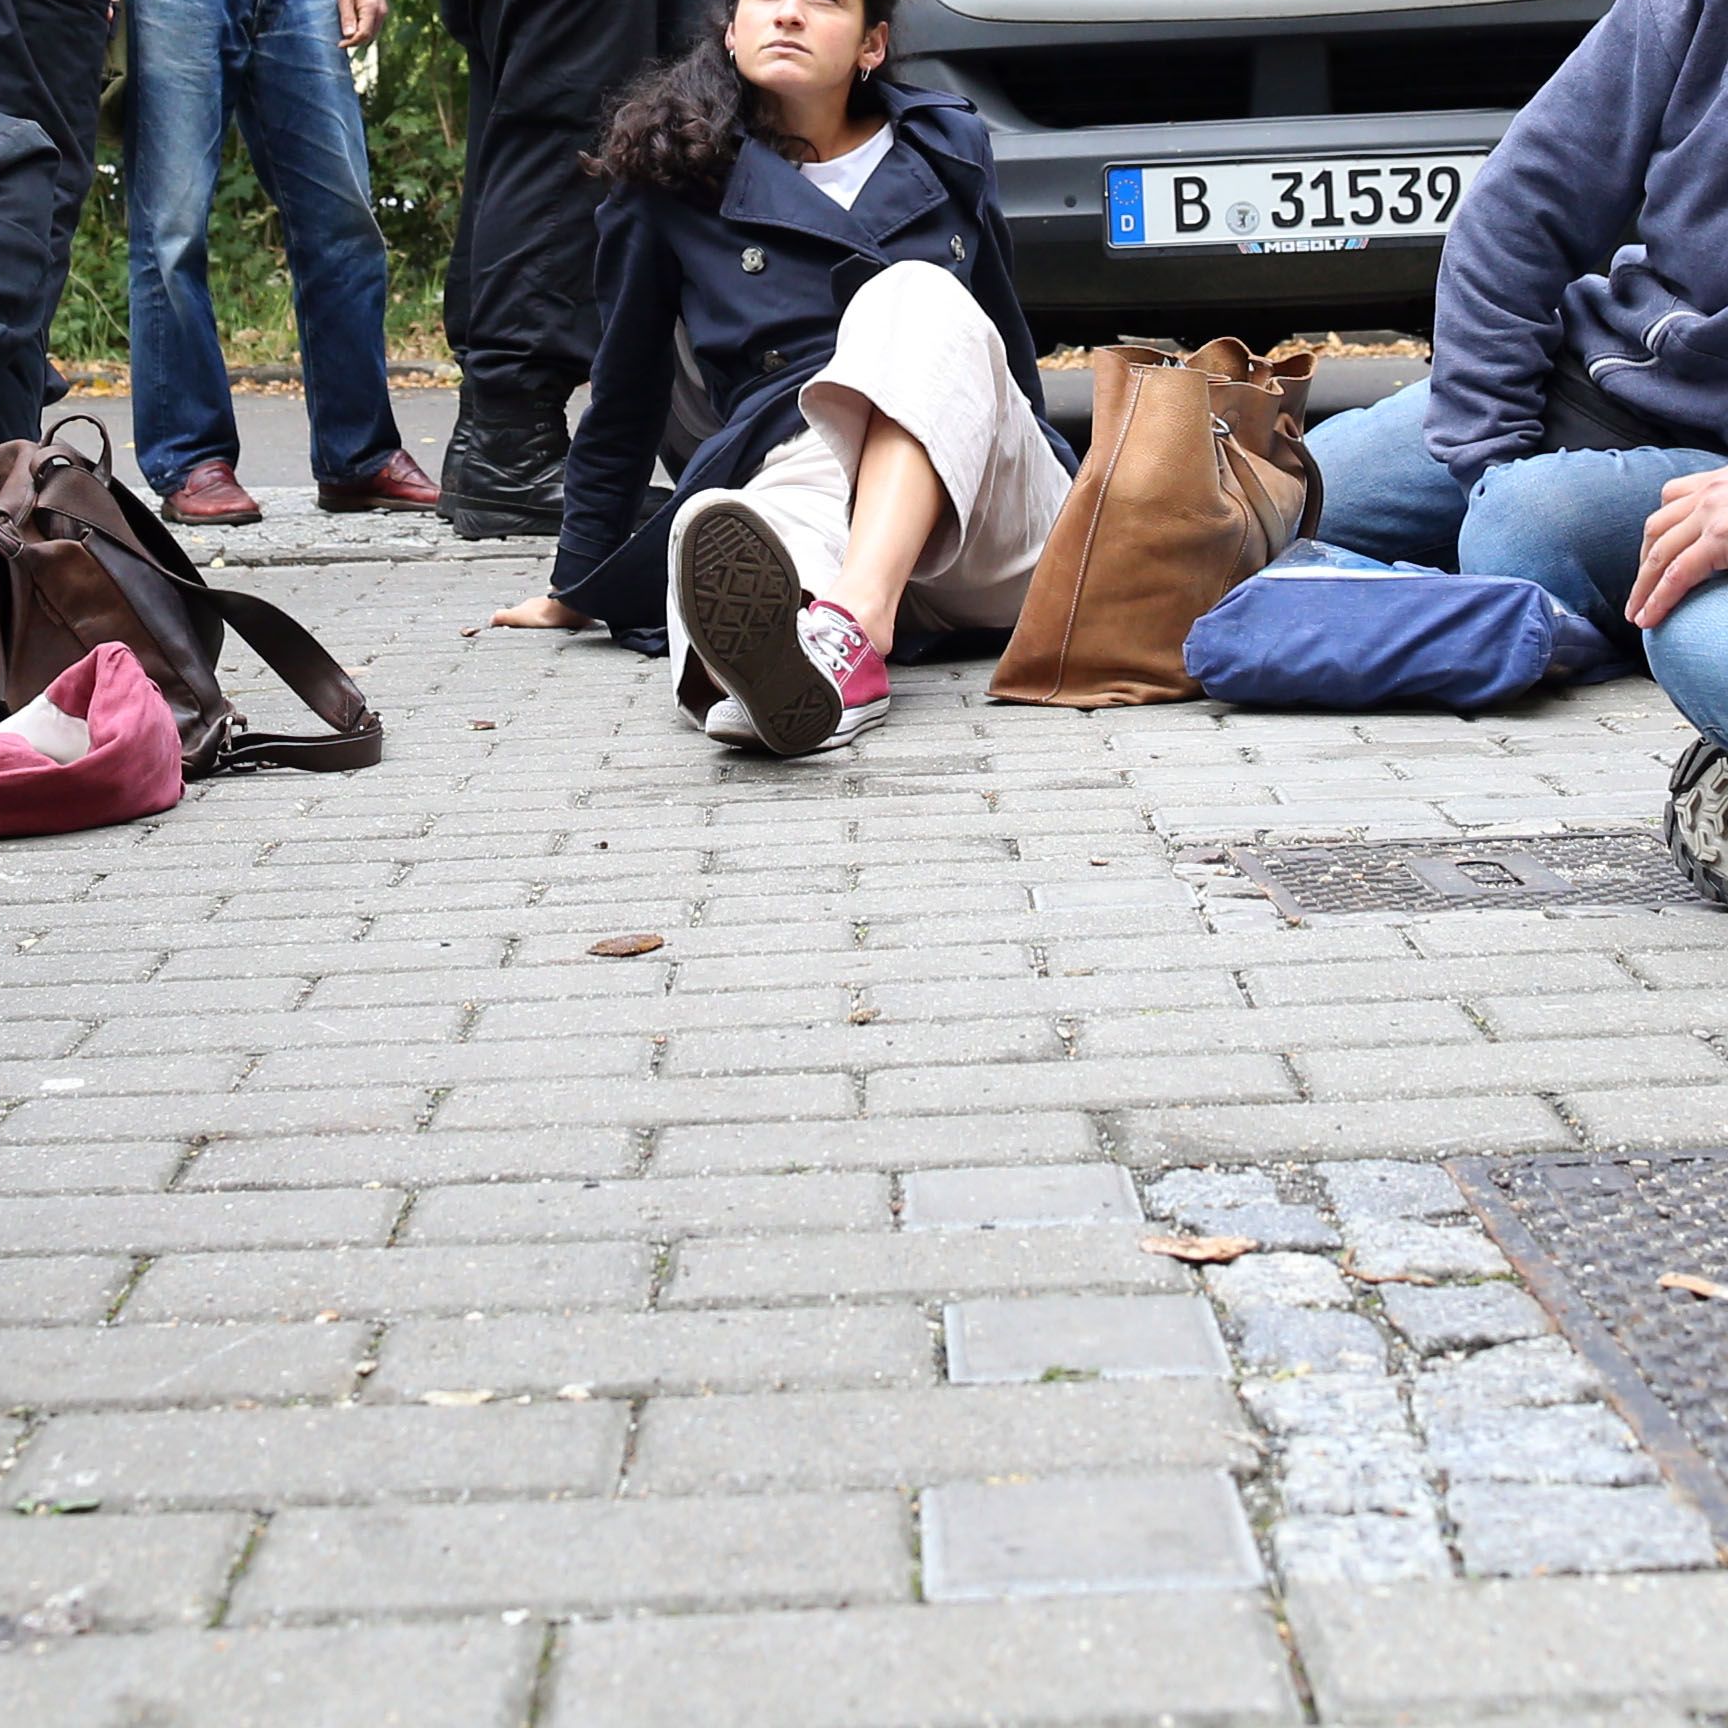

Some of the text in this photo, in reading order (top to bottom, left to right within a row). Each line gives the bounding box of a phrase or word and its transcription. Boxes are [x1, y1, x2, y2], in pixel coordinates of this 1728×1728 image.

[1173, 166, 1462, 233] B 31539
[1119, 213, 1136, 233] D
[1262, 238, 1346, 254] MOSOLF
